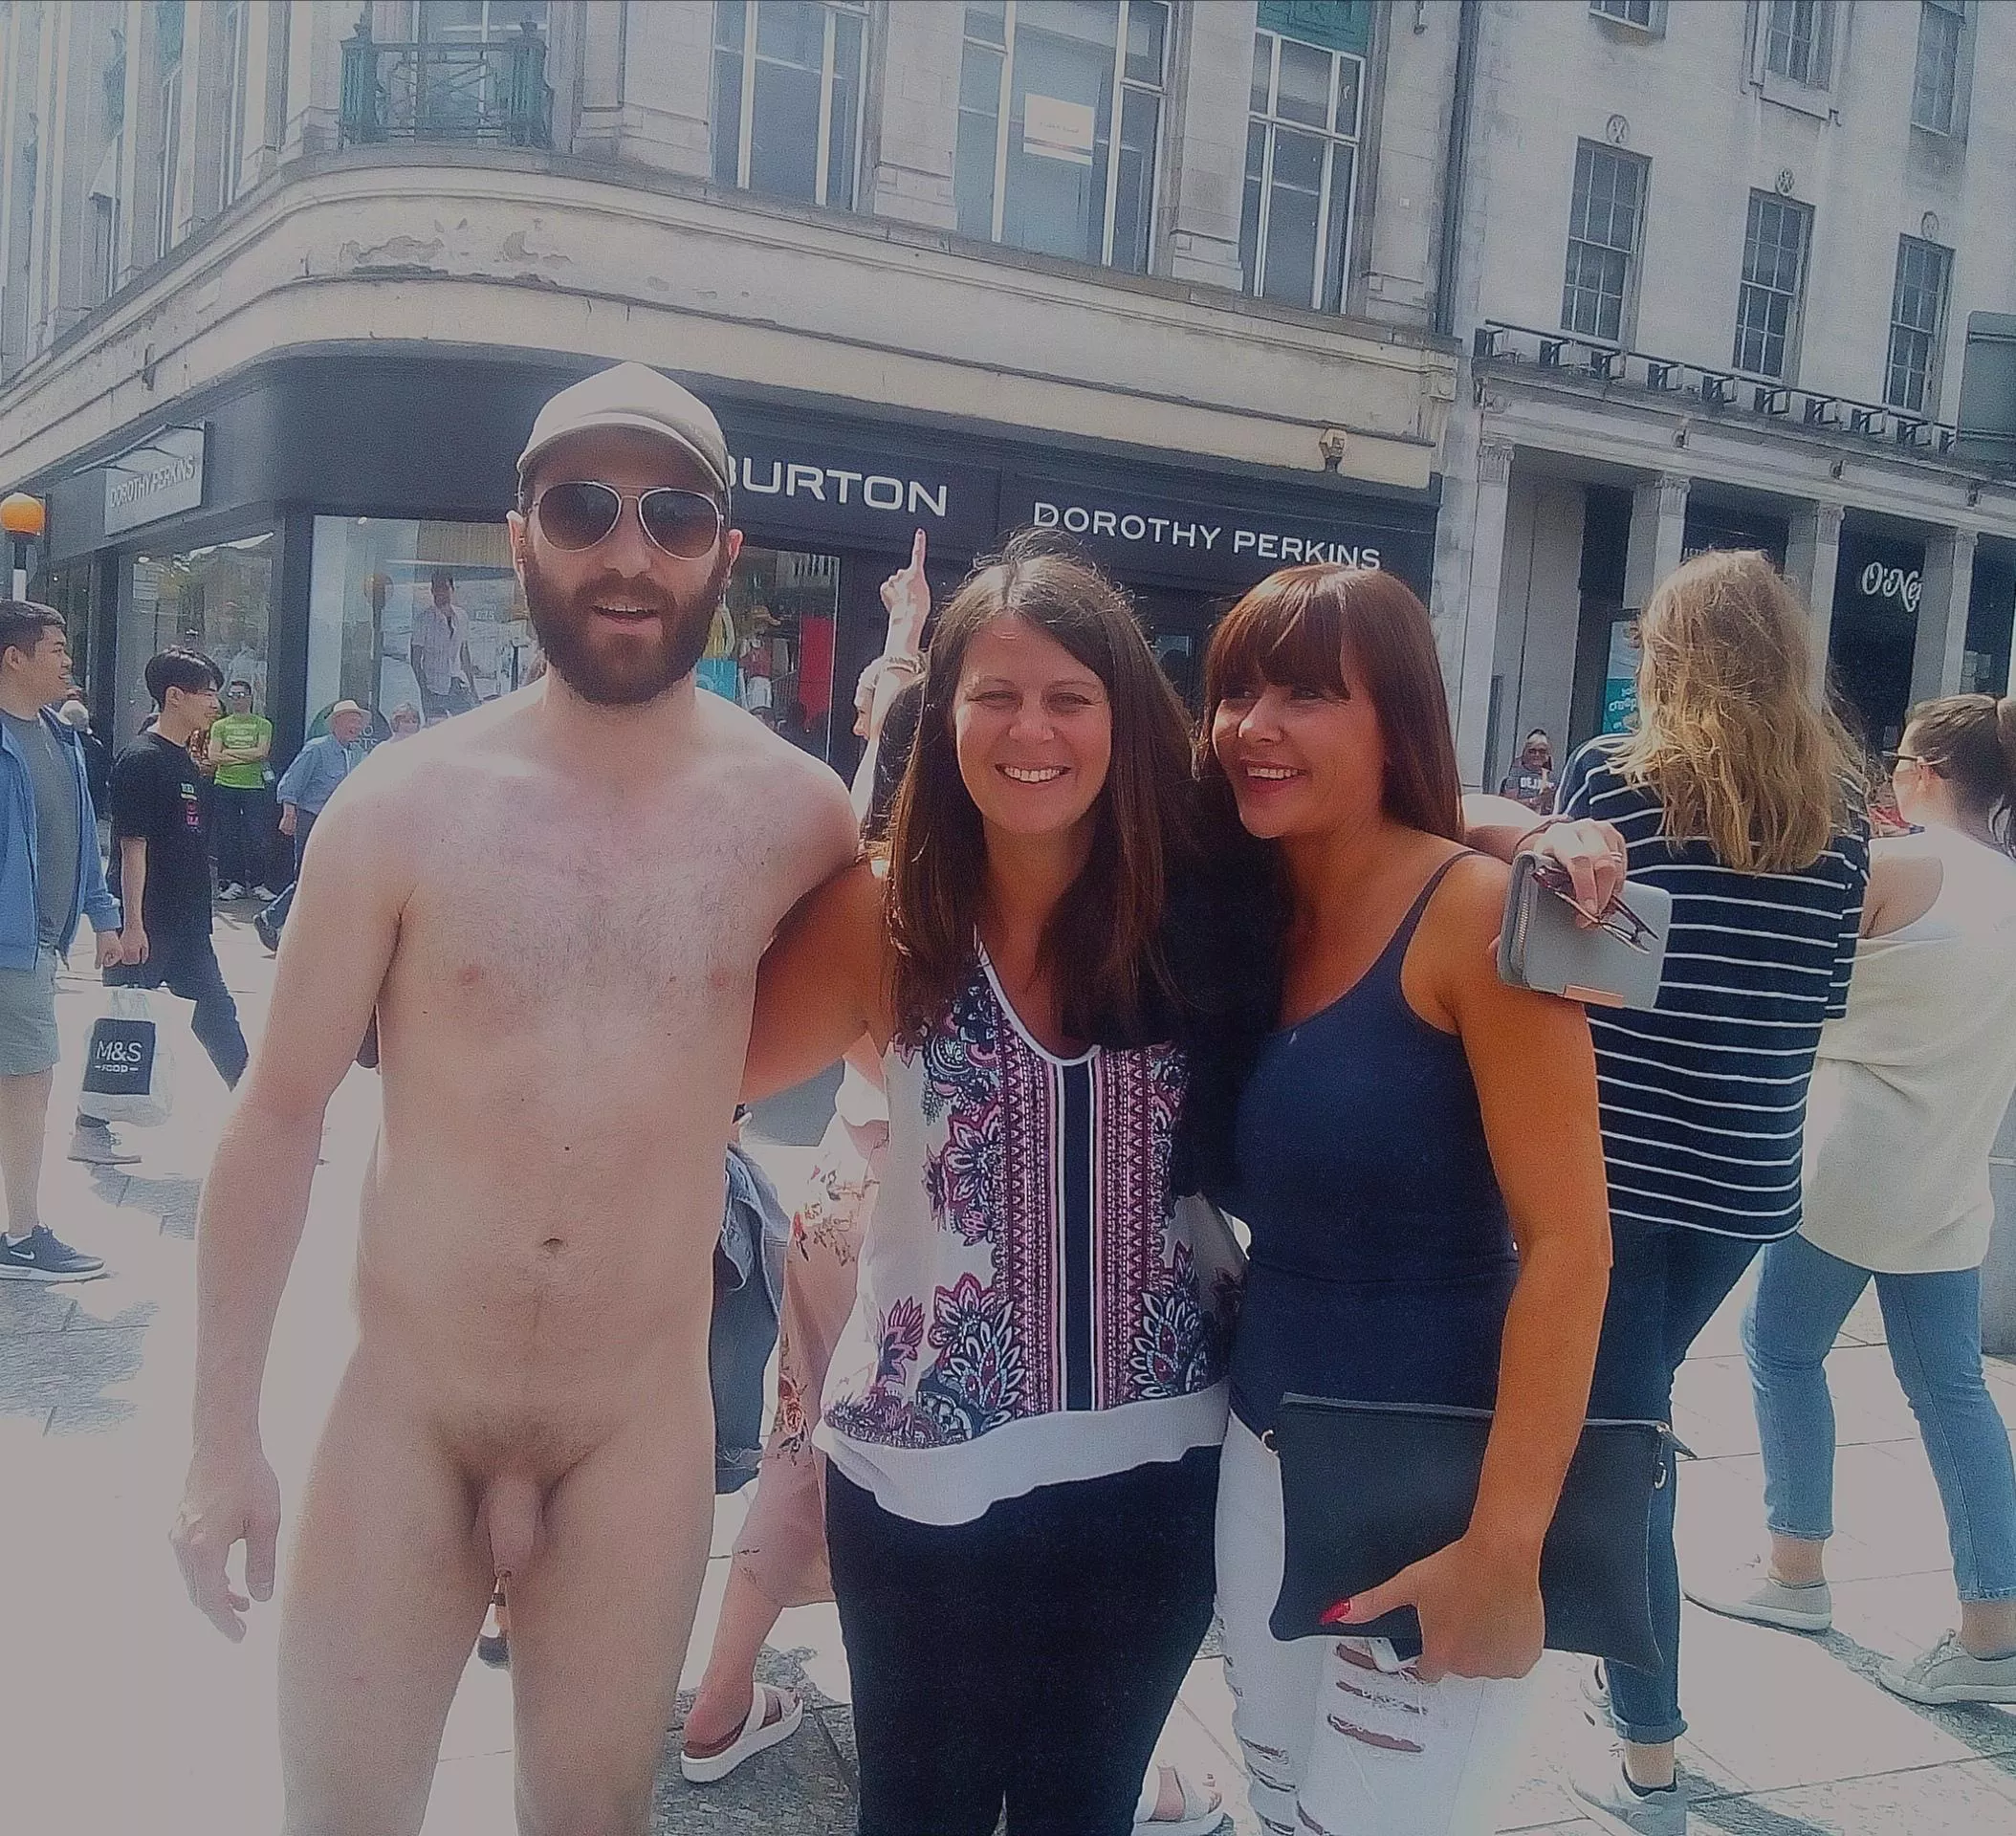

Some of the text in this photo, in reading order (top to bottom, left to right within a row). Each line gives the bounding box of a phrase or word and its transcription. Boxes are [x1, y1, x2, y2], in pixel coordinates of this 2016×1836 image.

[1033, 501, 1381, 572] DOROTHY PERKINS
[96, 1039, 143, 1063] M&S
